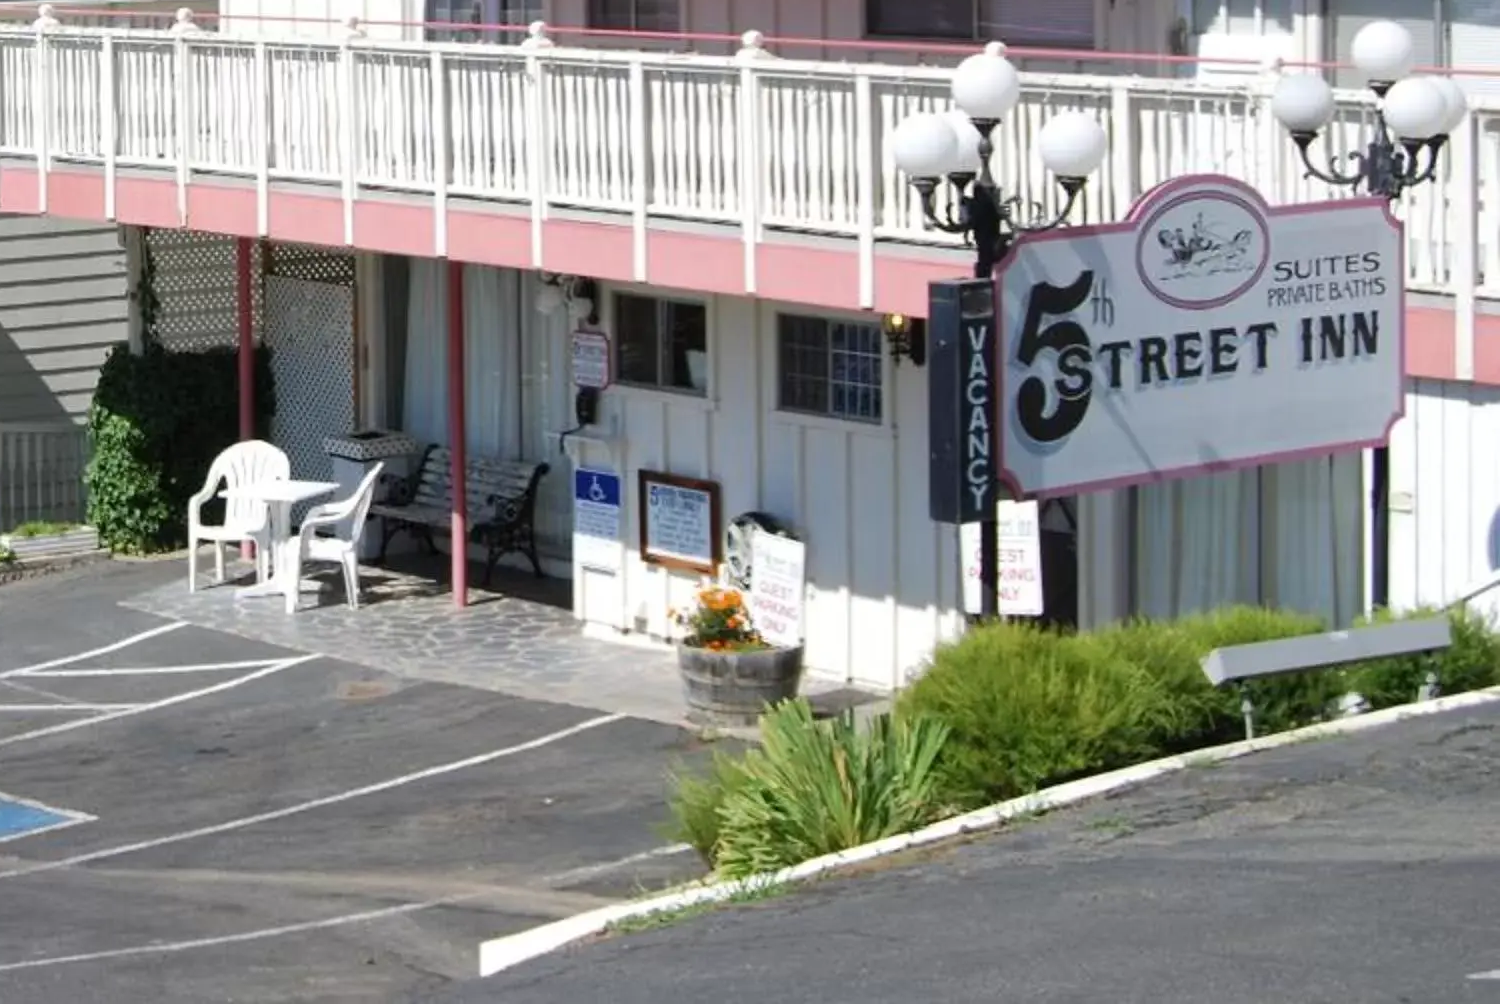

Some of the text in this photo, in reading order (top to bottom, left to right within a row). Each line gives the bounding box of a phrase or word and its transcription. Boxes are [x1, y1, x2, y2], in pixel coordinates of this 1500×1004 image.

[1273, 251, 1381, 283] SUITES
[1267, 276, 1387, 308] PRIVATE BATHS
[1055, 310, 1380, 401] STREET INN
[966, 324, 991, 513] VACANCY
[974, 548, 1026, 563] GEST
